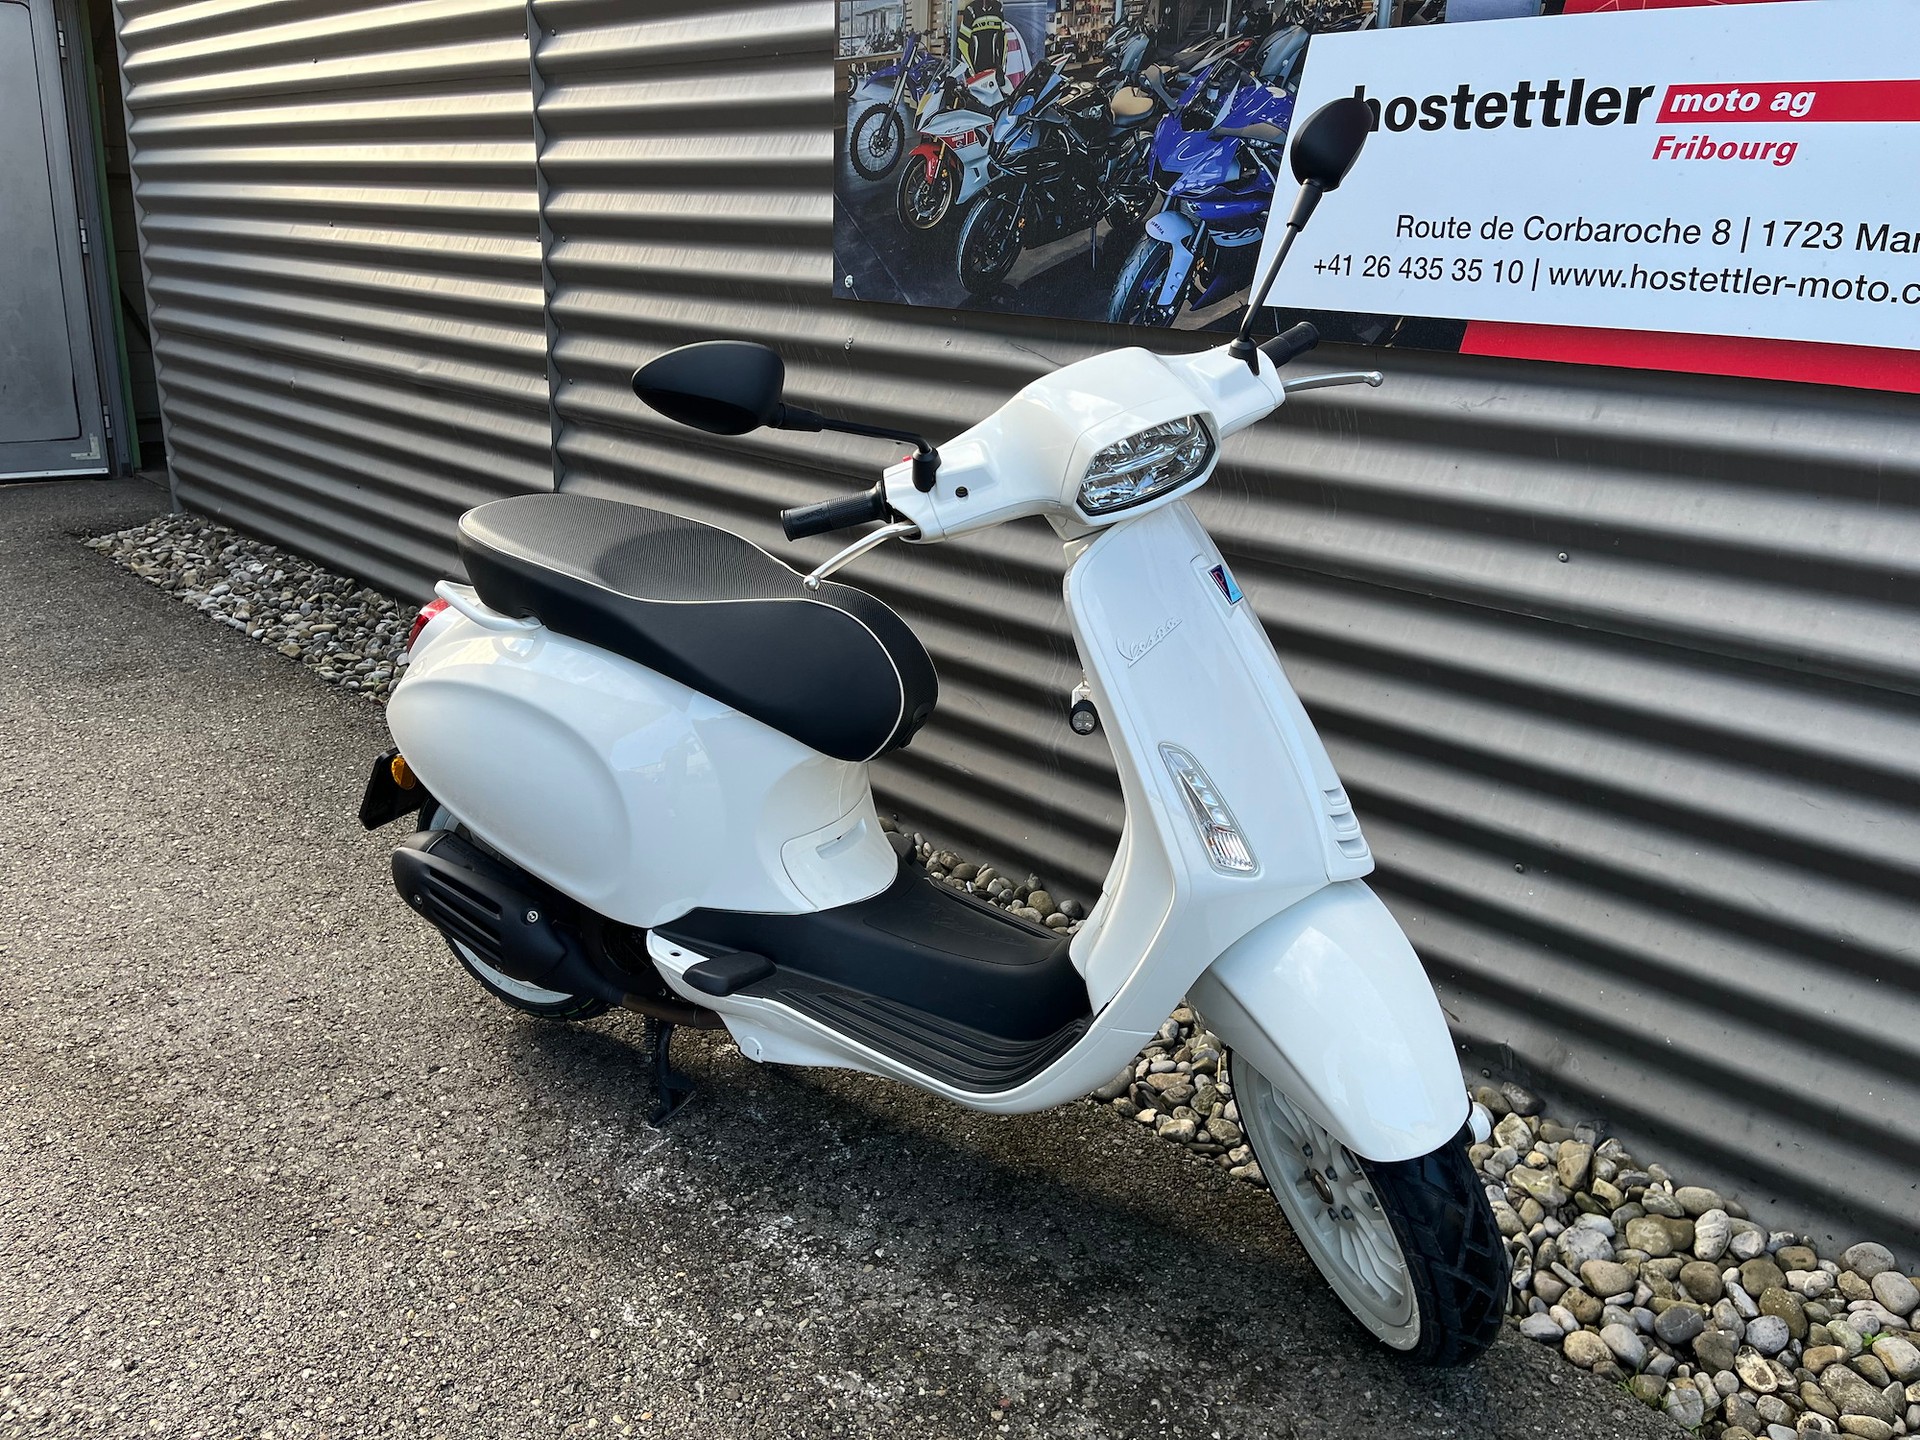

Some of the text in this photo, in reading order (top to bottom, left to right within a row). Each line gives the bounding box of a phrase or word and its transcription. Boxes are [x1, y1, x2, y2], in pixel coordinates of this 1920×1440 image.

[1669, 89, 1761, 113] moto
[1769, 91, 1816, 118] ag
[1652, 135, 1799, 167] Fribourg
[1396, 214, 1472, 239] Route
[1480, 215, 1514, 240] de
[1523, 215, 1701, 244] Corbaroche
[1711, 218, 1732, 246] 8
[1762, 220, 1844, 250] 1723
[1313, 253, 1352, 277] +41
[1362, 254, 1392, 278] 26
[1398, 256, 1444, 281] 435
[1451, 258, 1483, 282] 35
[1493, 259, 1525, 284] 10
[1549, 262, 1920, 305] www.hostettler-moto.c
